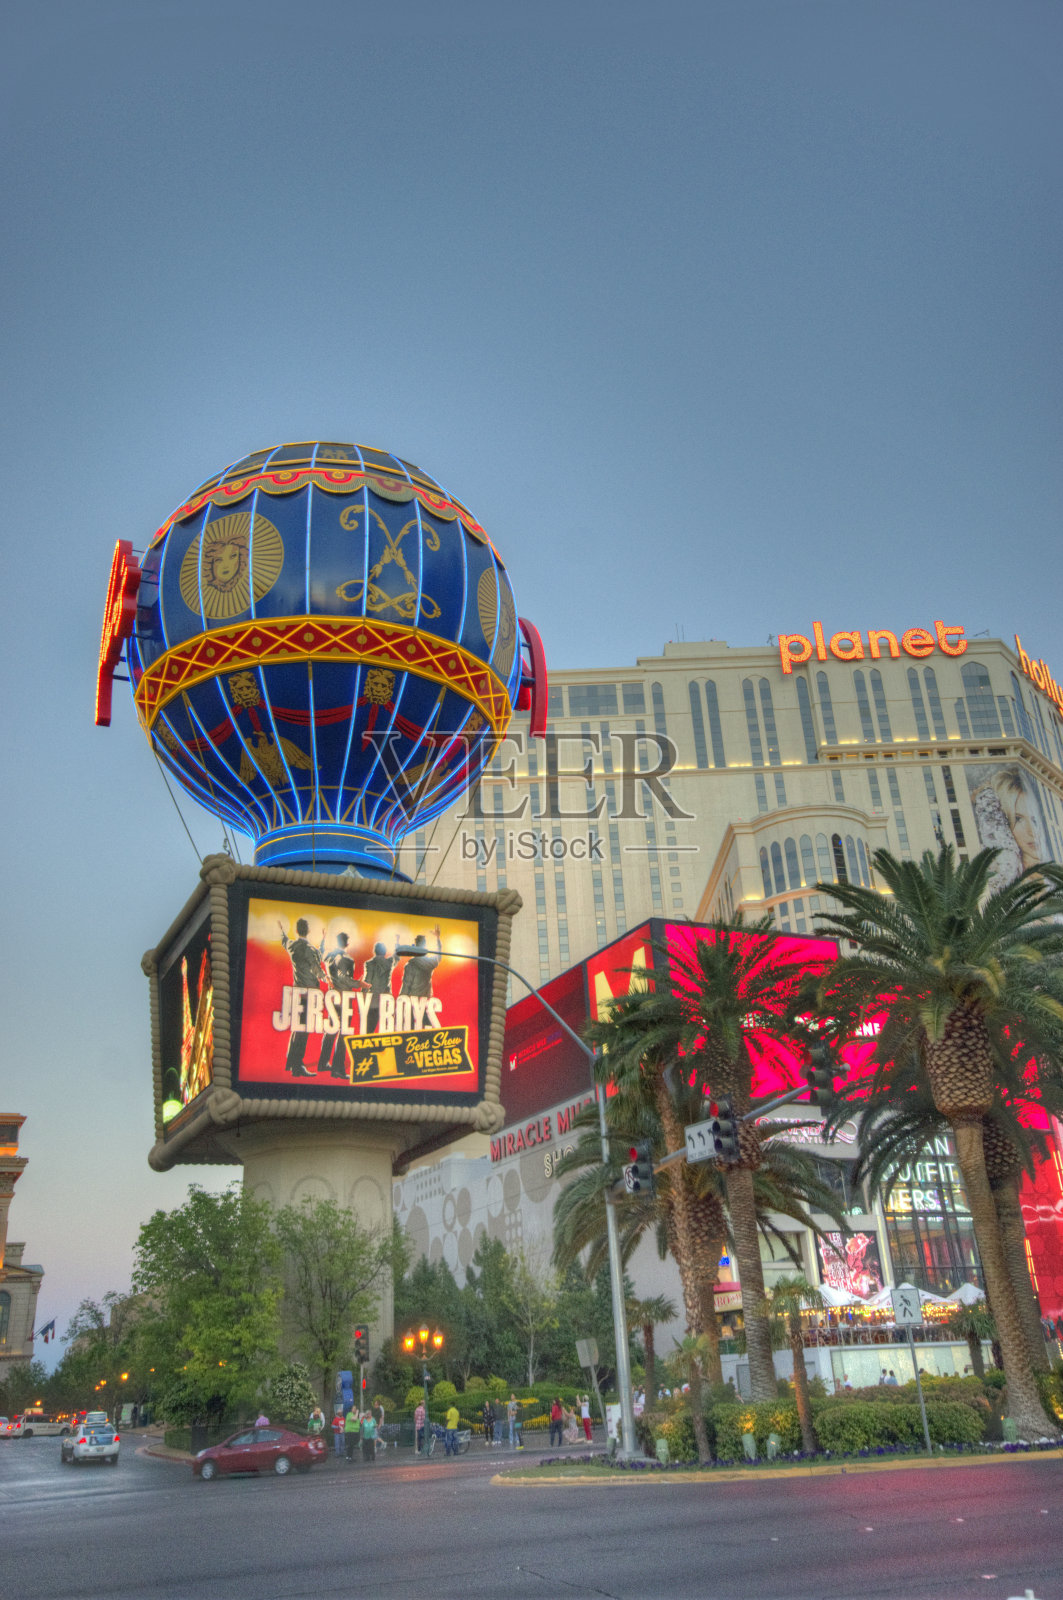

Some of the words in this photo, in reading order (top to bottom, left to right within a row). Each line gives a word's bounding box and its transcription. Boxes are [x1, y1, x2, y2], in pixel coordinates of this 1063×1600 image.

[778, 620, 968, 674] planet
[272, 985, 373, 1035] JERSEY
[378, 993, 443, 1034] BOYS
[351, 1036, 403, 1050] RATED
[406, 1036, 430, 1053] Best
[432, 1031, 462, 1049] Show
[413, 1047, 463, 1068] VEGAS
[490, 1117, 551, 1162] MIRACLE
